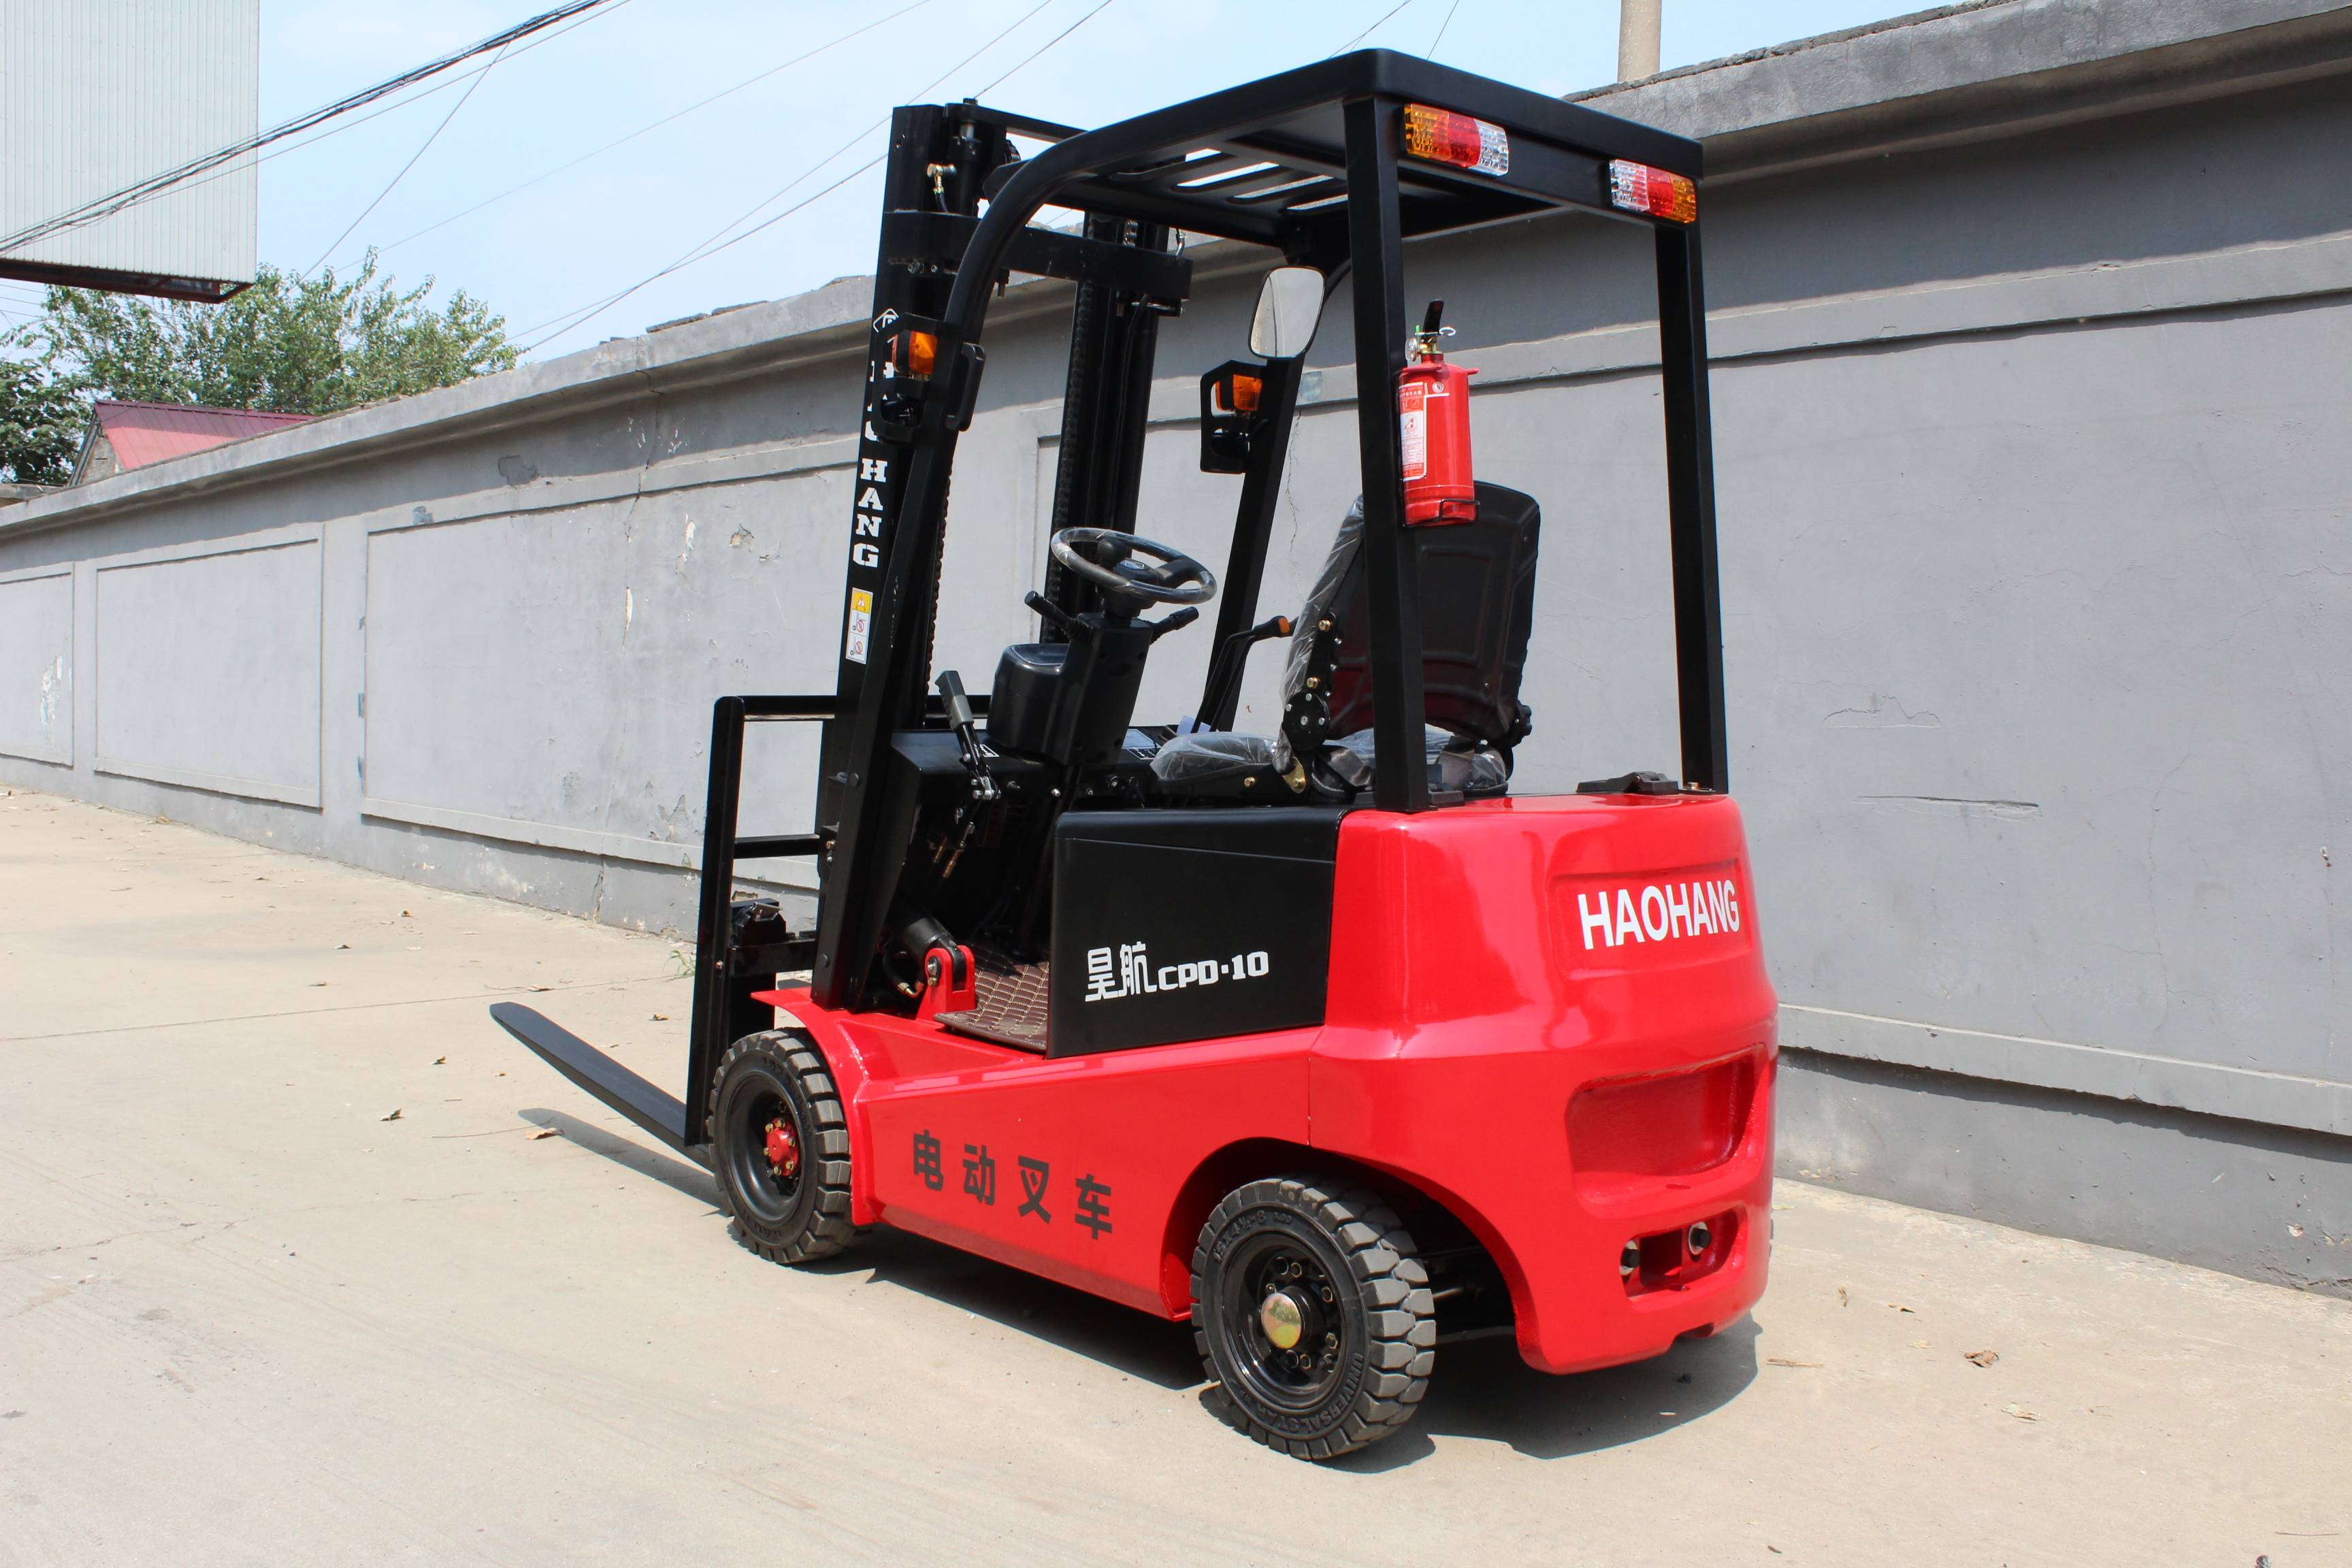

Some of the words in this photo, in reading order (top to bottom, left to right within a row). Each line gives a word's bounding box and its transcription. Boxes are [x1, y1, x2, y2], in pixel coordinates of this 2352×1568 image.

[1578, 879, 1740, 950] HAOHANG
[913, 1129, 1113, 1241] 电动叉车
